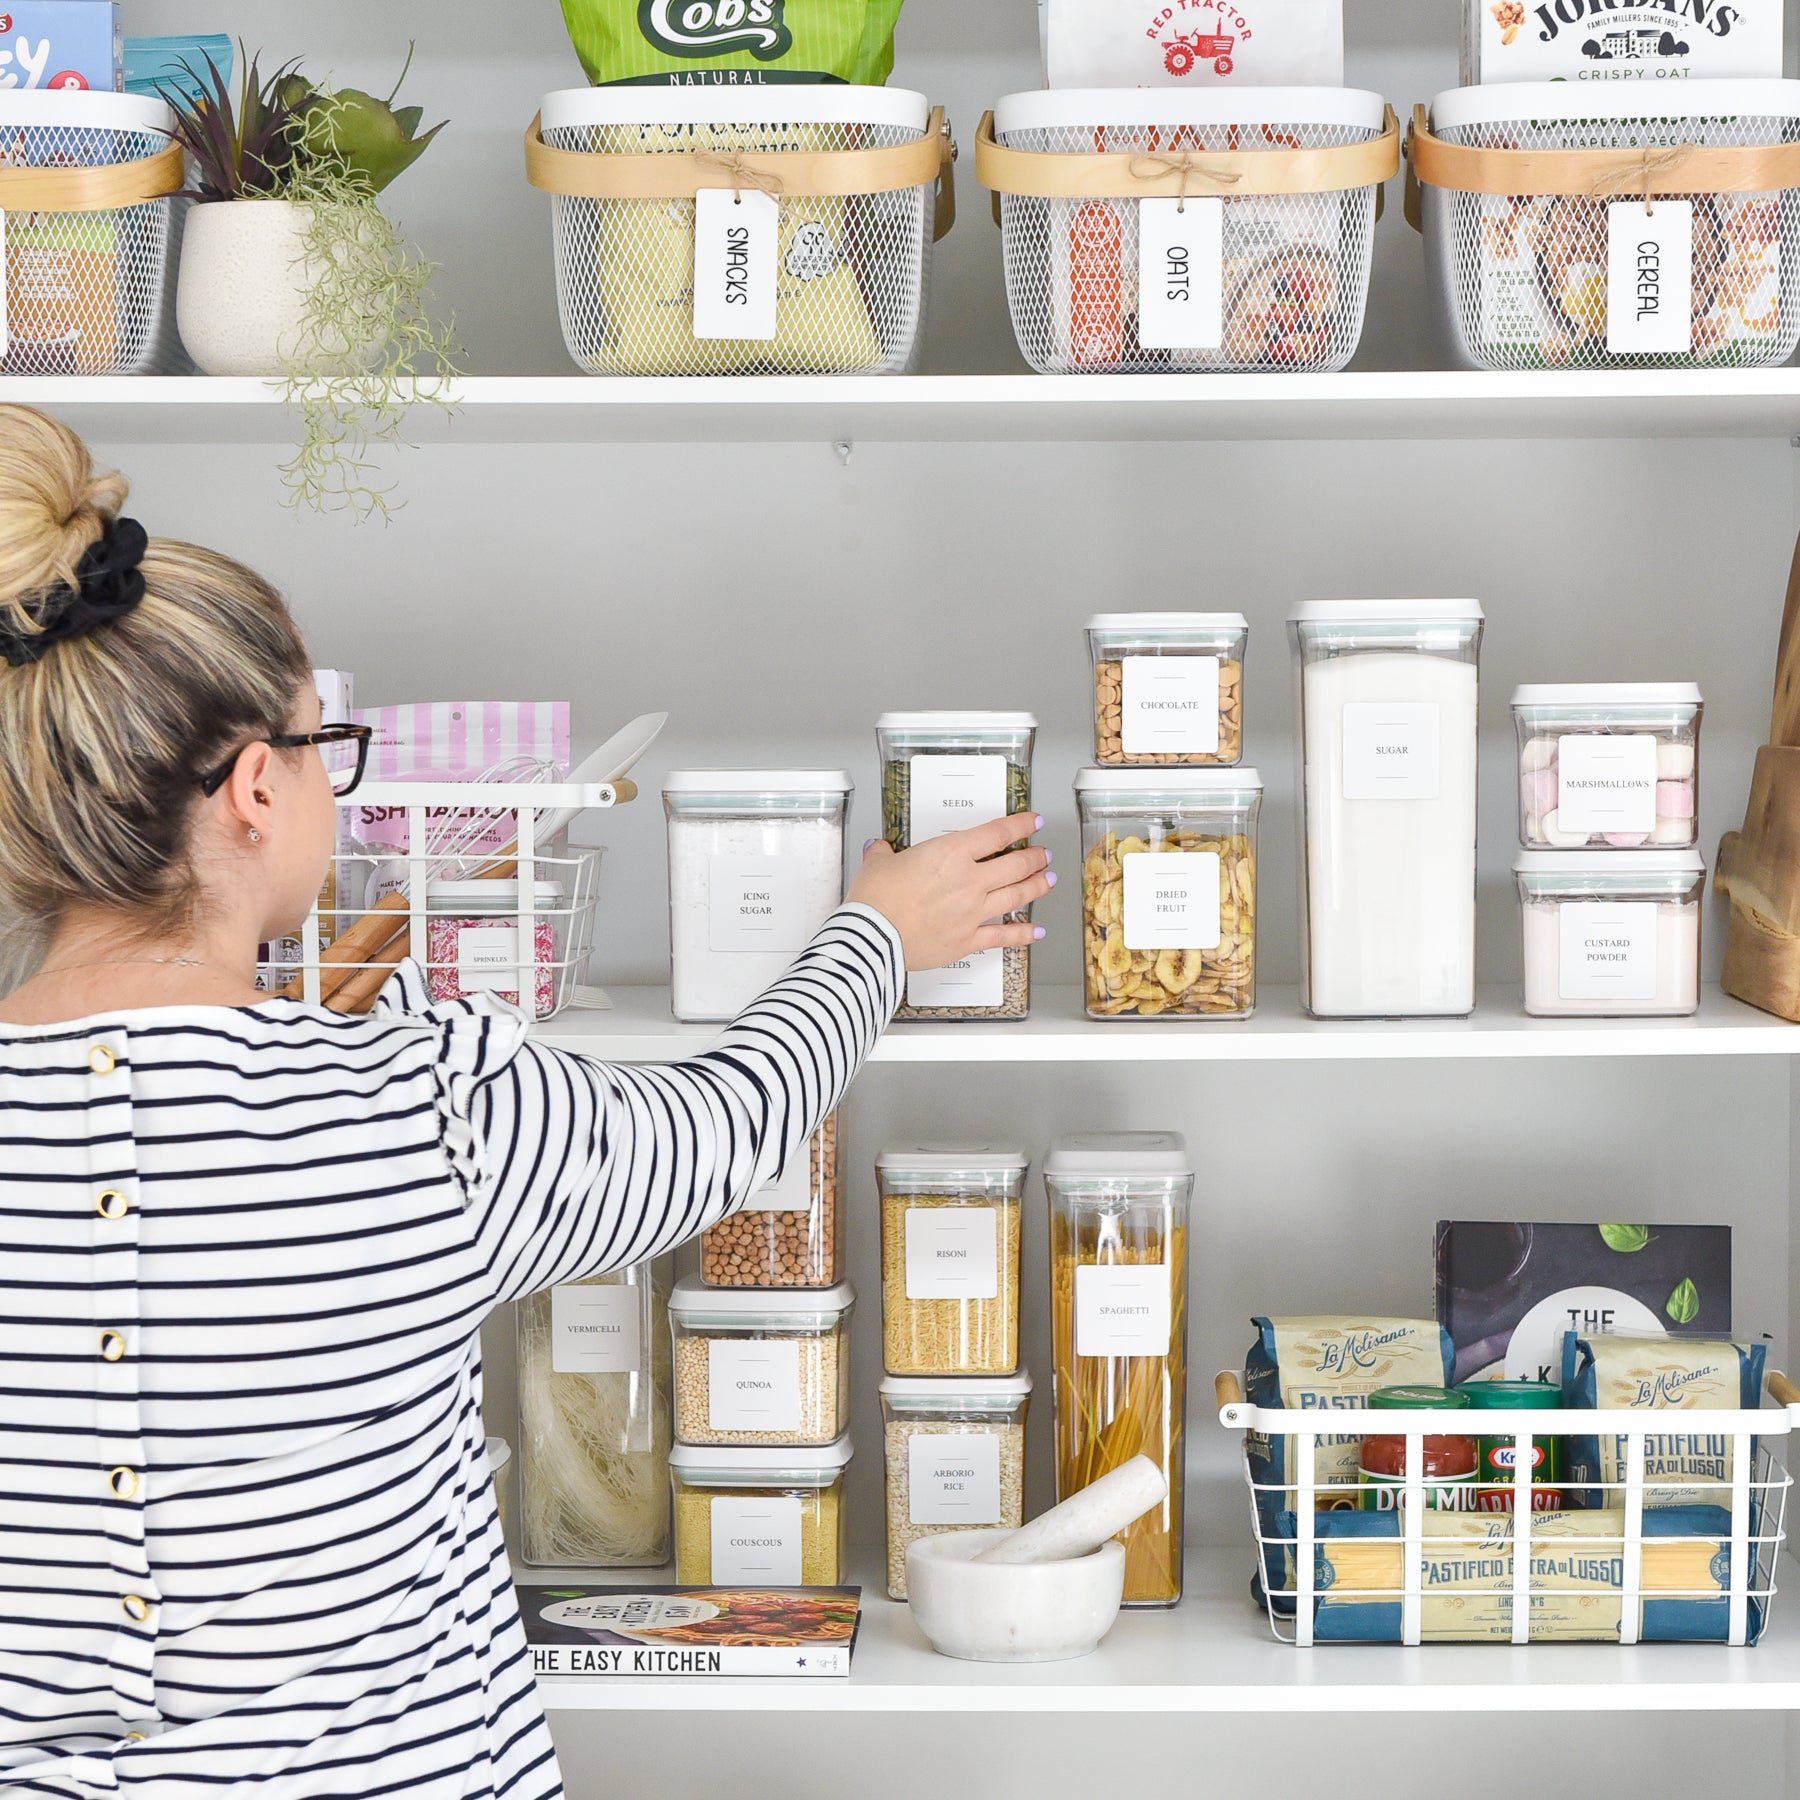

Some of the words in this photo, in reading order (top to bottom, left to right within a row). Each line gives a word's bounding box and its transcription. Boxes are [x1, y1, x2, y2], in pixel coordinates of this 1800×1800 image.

[1146, 8, 1173, 39] RED
[1178, 0, 1252, 42] TRACTOR
[1534, 0, 1740, 41] JONS
[1587, 18, 1611, 30] FAMILY
[1613, 14, 1641, 24] MILLERS
[1643, 14, 1662, 25] SINCE
[1664, 17, 1679, 28] 1855
[670, 71, 767, 86] NATURAL
[1578, 68, 1645, 80] CRISPY
[1655, 68, 1691, 79] OAT
[725, 227, 749, 306] SNACKS
[1166, 246, 1190, 302] OATS
[1636, 241, 1660, 322] CEREAL
[1140, 701, 1198, 710] CHOCOLATE
[1375, 746, 1409, 755] SUGAR
[1566, 780, 1650, 789] MARSHMALLOWS
[942, 799, 974, 808] SEEDS
[743, 892, 771, 901] ICING
[1156, 890, 1188, 899] DRIED
[739, 906, 773, 915] SUGAR
[1156, 904, 1187, 913] FRUIT
[1584, 939, 1630, 948] CUSTARD
[1586, 953, 1627, 961] POWDER
[936, 1250, 967, 1258] RISONI
[1099, 1306, 1150, 1315] SPAGHETTI
[1567, 1309, 1615, 1333] THE
[567, 1325, 621, 1333] VERMICELLI
[736, 1381, 772, 1390] QUINOA
[1616, 1433, 1725, 1460] PSTIFICIO
[933, 1469, 975, 1478] ARBORIO
[1681, 1457, 1726, 1481] LUSSO
[943, 1482, 965, 1491] RICE
[1646, 1488, 1679, 1501] Bronze
[1680, 1487, 1698, 1497] Die
[730, 1538, 784, 1547] COUSCOUS
[1569, 1557, 1624, 1587] LUSSO
[529, 1650, 559, 1671] HE
[570, 1650, 623, 1671] EASY
[634, 1650, 721, 1672] KITCHEN
